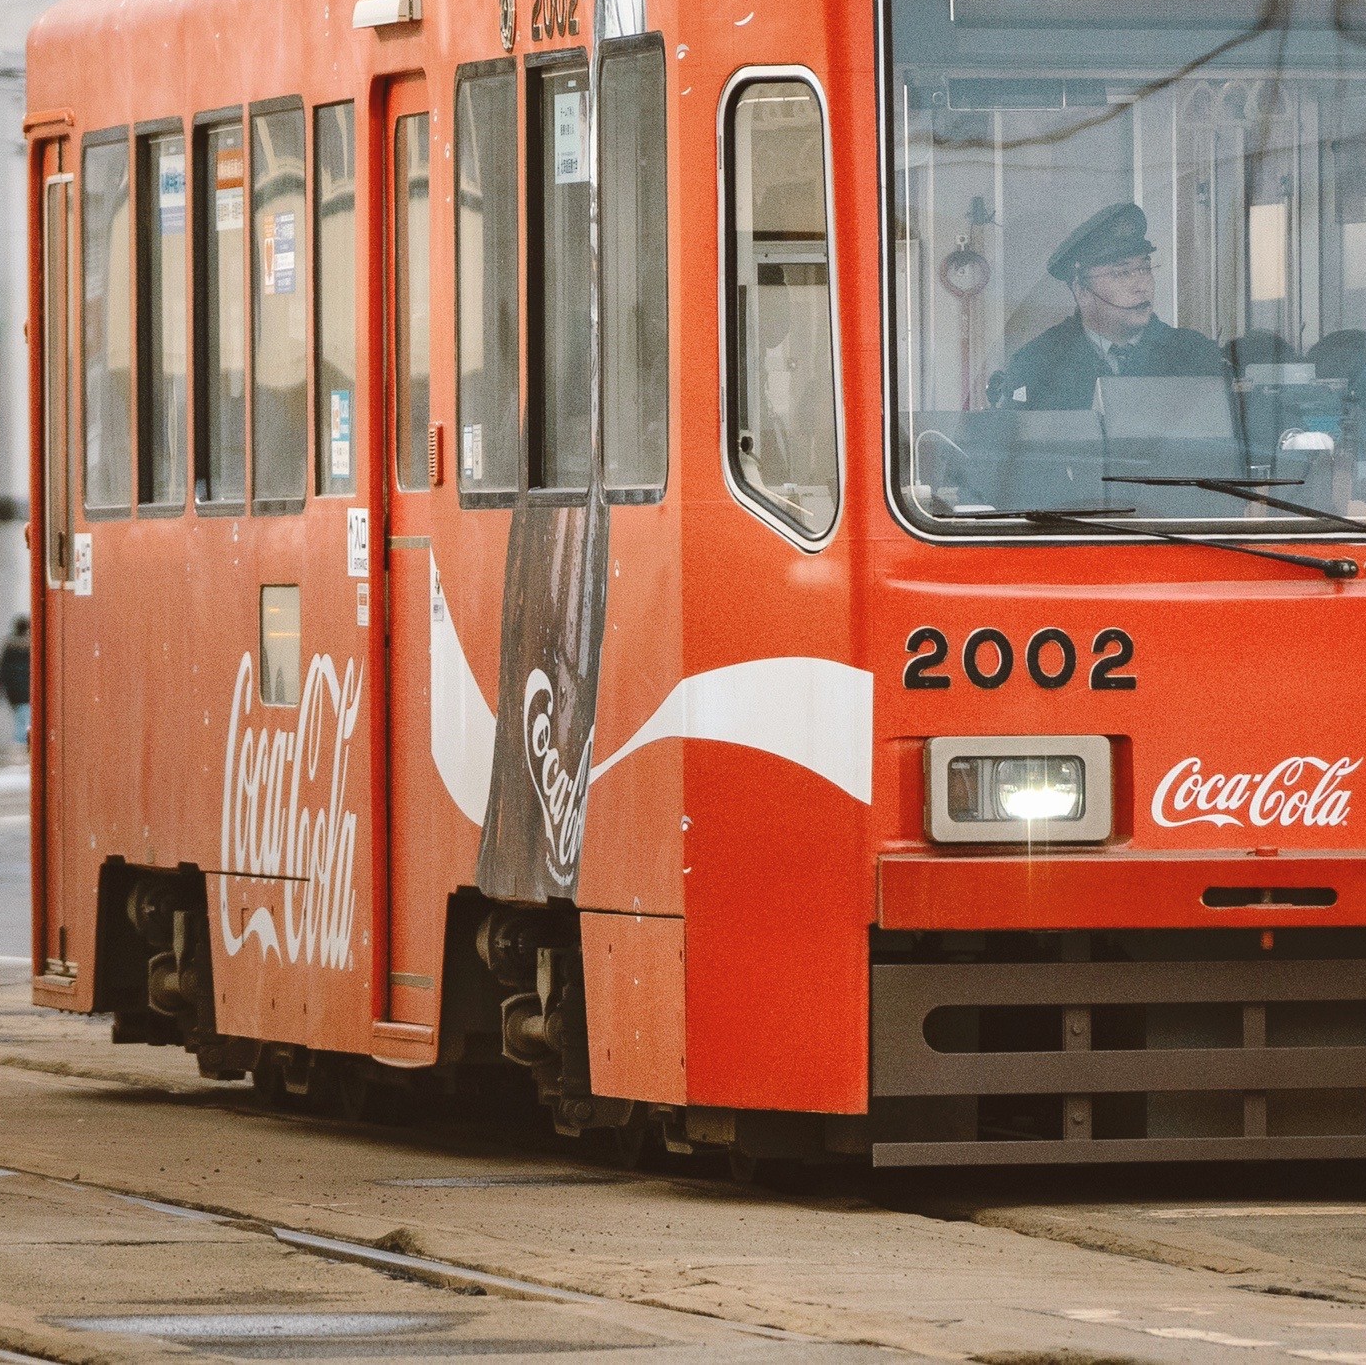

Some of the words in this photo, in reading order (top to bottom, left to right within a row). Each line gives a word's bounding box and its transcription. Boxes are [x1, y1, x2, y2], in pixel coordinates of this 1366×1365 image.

[902, 625, 1137, 691] 2002
[220, 651, 364, 972] Coca-Cola
[1151, 756, 1363, 828] Coca-Cola
